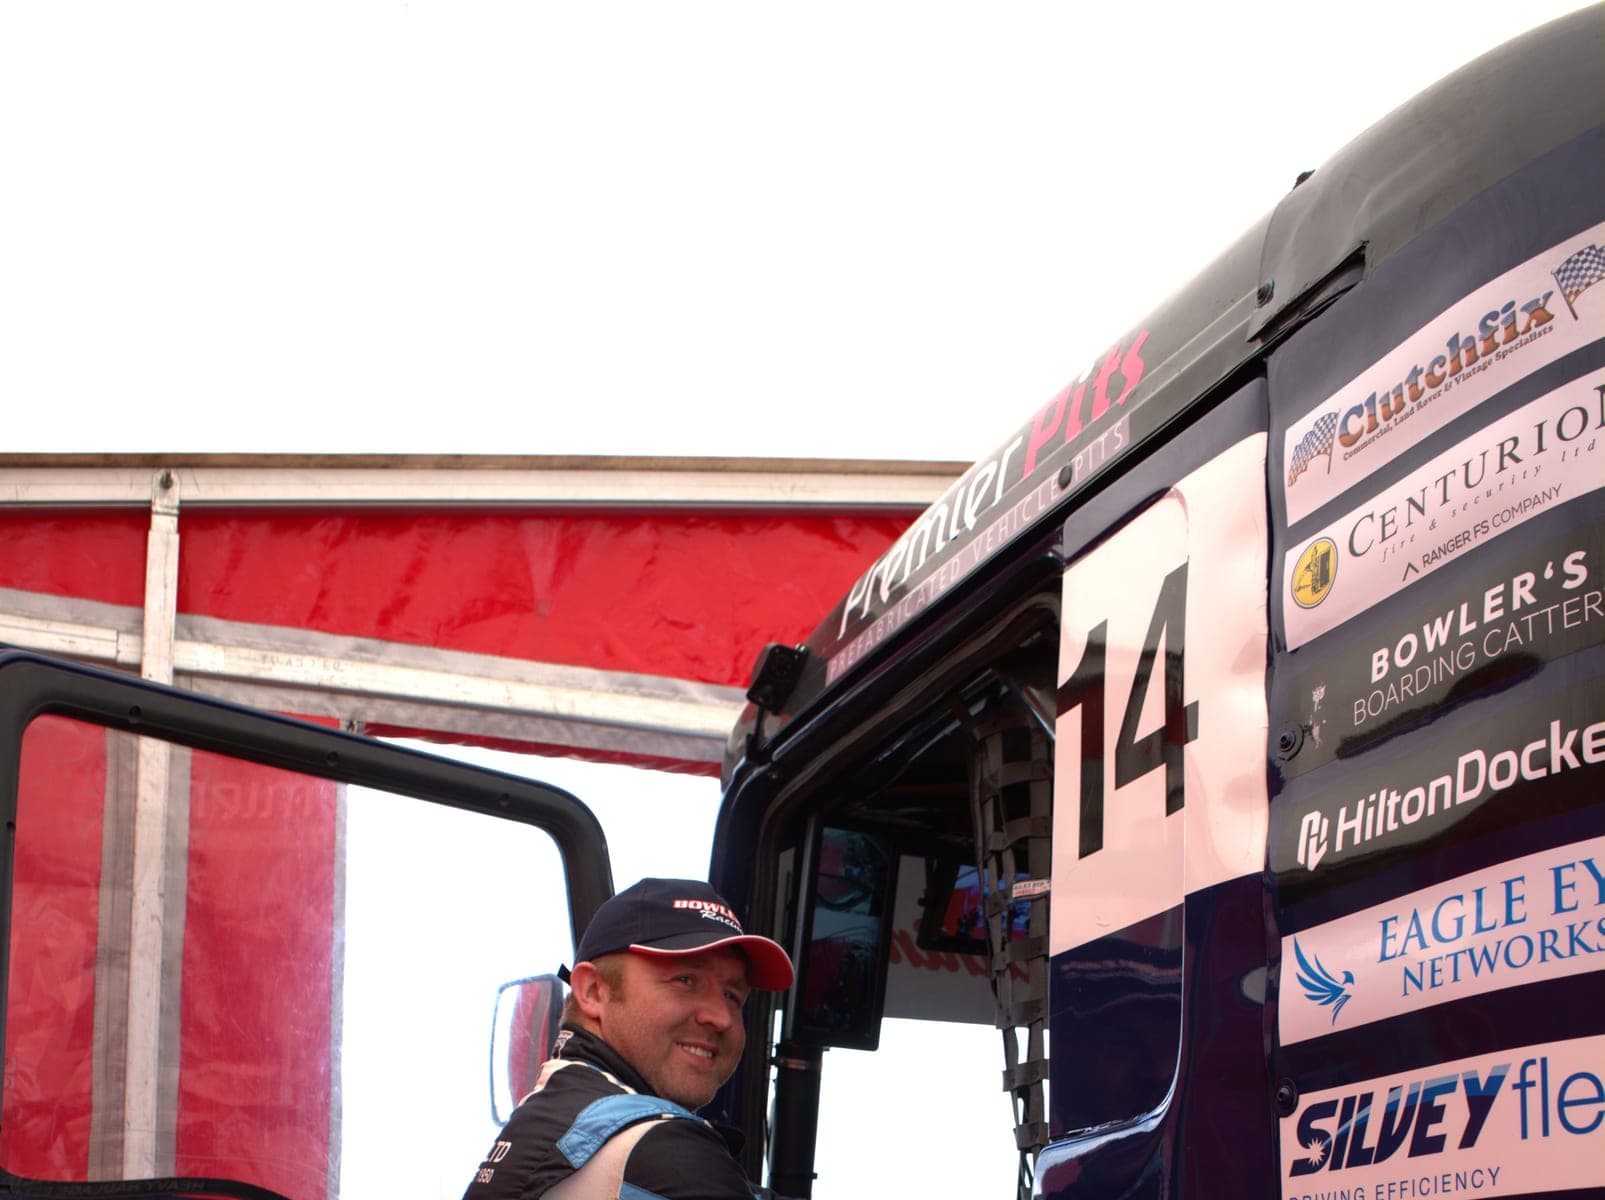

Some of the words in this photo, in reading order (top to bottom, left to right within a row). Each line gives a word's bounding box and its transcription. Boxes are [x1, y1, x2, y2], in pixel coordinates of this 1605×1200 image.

[1338, 290, 1555, 448] Clutchfix
[1394, 410, 1416, 428] Land
[1416, 390, 1443, 414] Rover
[1444, 382, 1453, 393] &
[1454, 360, 1493, 386] Vintage
[1495, 325, 1554, 362] Specialists
[830, 558, 961, 680] PREFABRICATED
[972, 473, 1060, 562] VEHICLE
[1072, 421, 1124, 486] PITS
[1382, 534, 1416, 563] fire
[1429, 518, 1438, 531] &
[1452, 464, 1542, 518] security
[1561, 439, 1597, 463] ltd
[1422, 530, 1472, 568] RANGER
[1473, 519, 1490, 540] FS
[1492, 483, 1563, 528] COMPANY
[1353, 642, 1476, 726] BOARDING
[1482, 591, 1605, 658] CATTER
[1371, 550, 1588, 684] BOWLER'S
[1055, 555, 1199, 861] 14
[1335, 719, 1605, 853] HiltonDocke
[1377, 876, 1527, 964] EAGLE
[1289, 1062, 1513, 1178] SILVEY
[1512, 1056, 1605, 1140] fle
